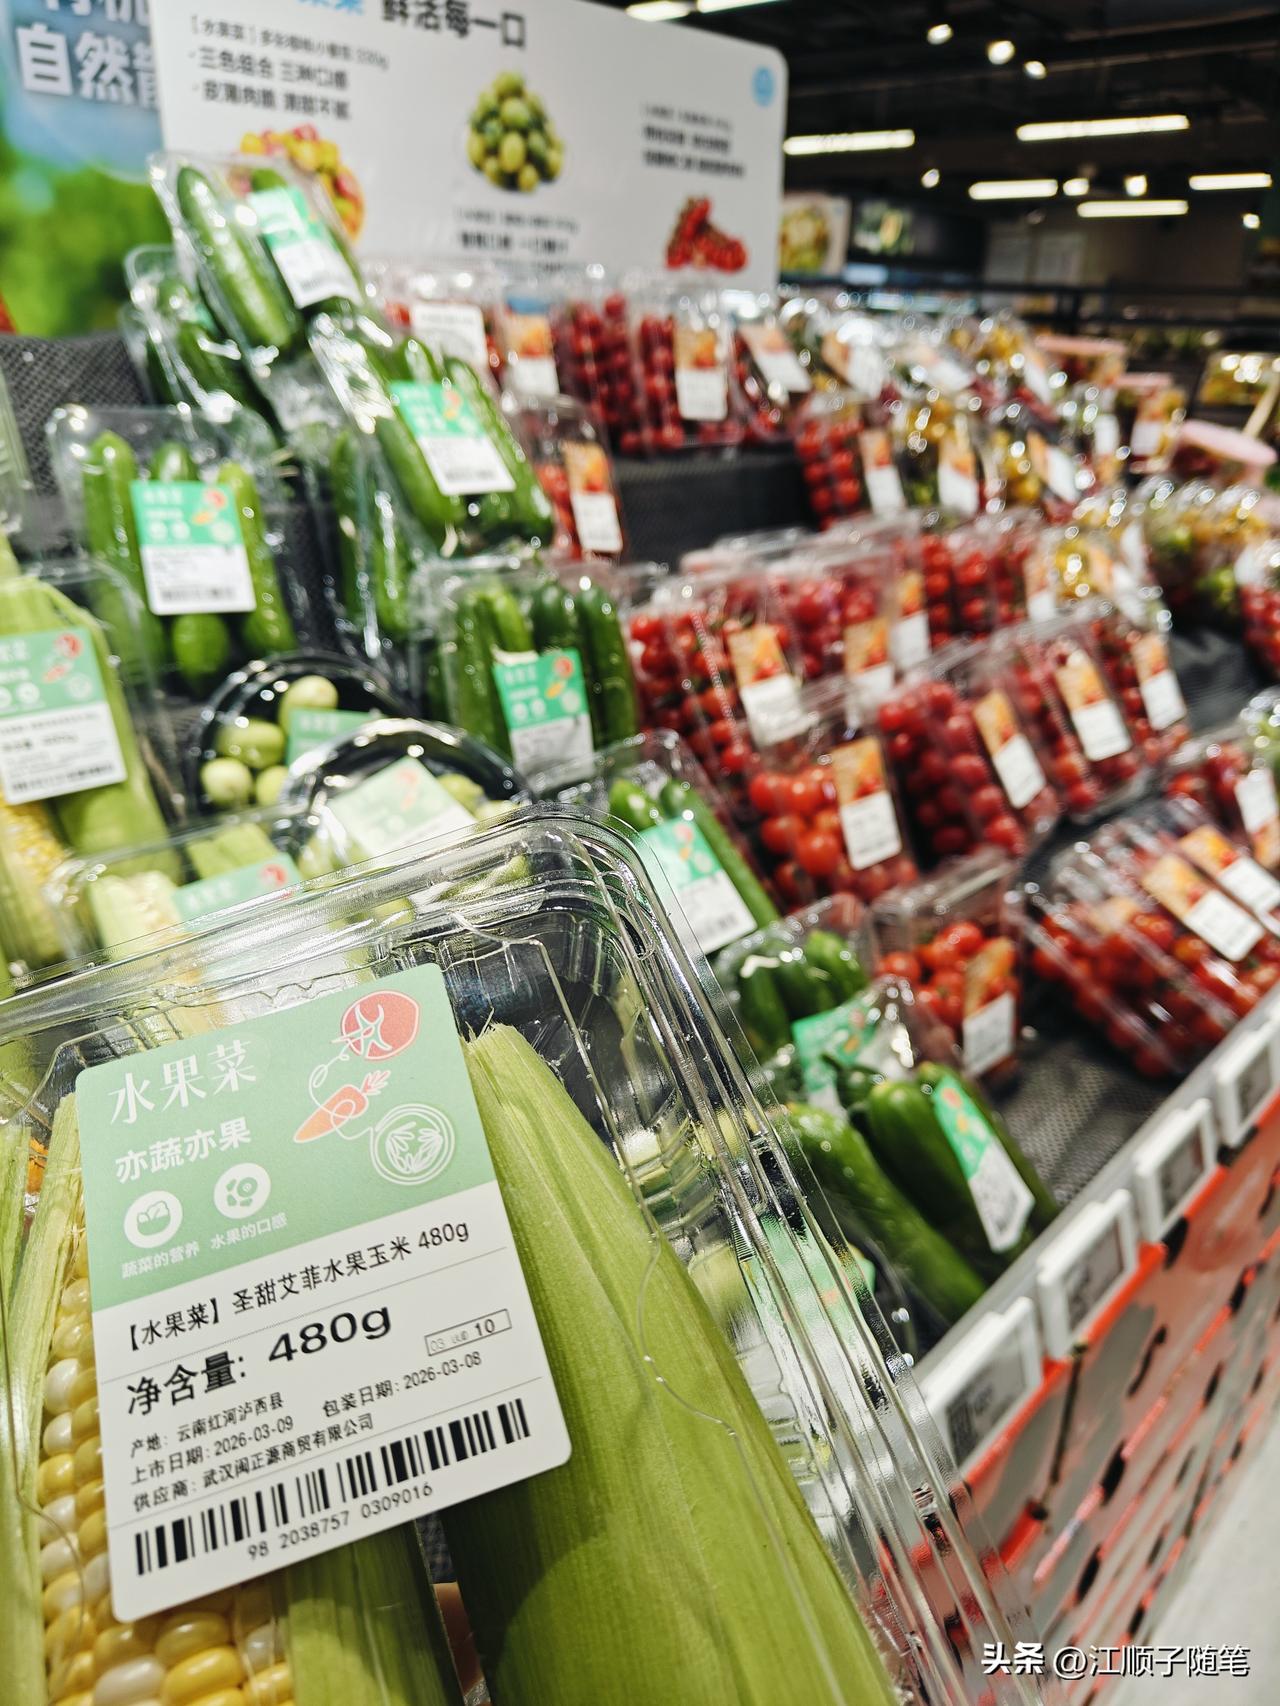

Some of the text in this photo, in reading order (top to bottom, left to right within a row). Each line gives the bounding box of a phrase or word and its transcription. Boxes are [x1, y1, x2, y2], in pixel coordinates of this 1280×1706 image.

[108, 1040, 257, 1126] 水果菜
[115, 1116, 252, 1184] 亦蔬亦果
[121, 1212, 288, 1280] 蔬菜的营养 水果的口感
[128, 1220, 470, 1351] 【水果菜】 圣甜艾菲水果玉米 480g
[268, 1306, 392, 1363] 480g
[474, 1318, 496, 1337] 10
[247, 1482, 433, 1562] 98 2038757 0309016
